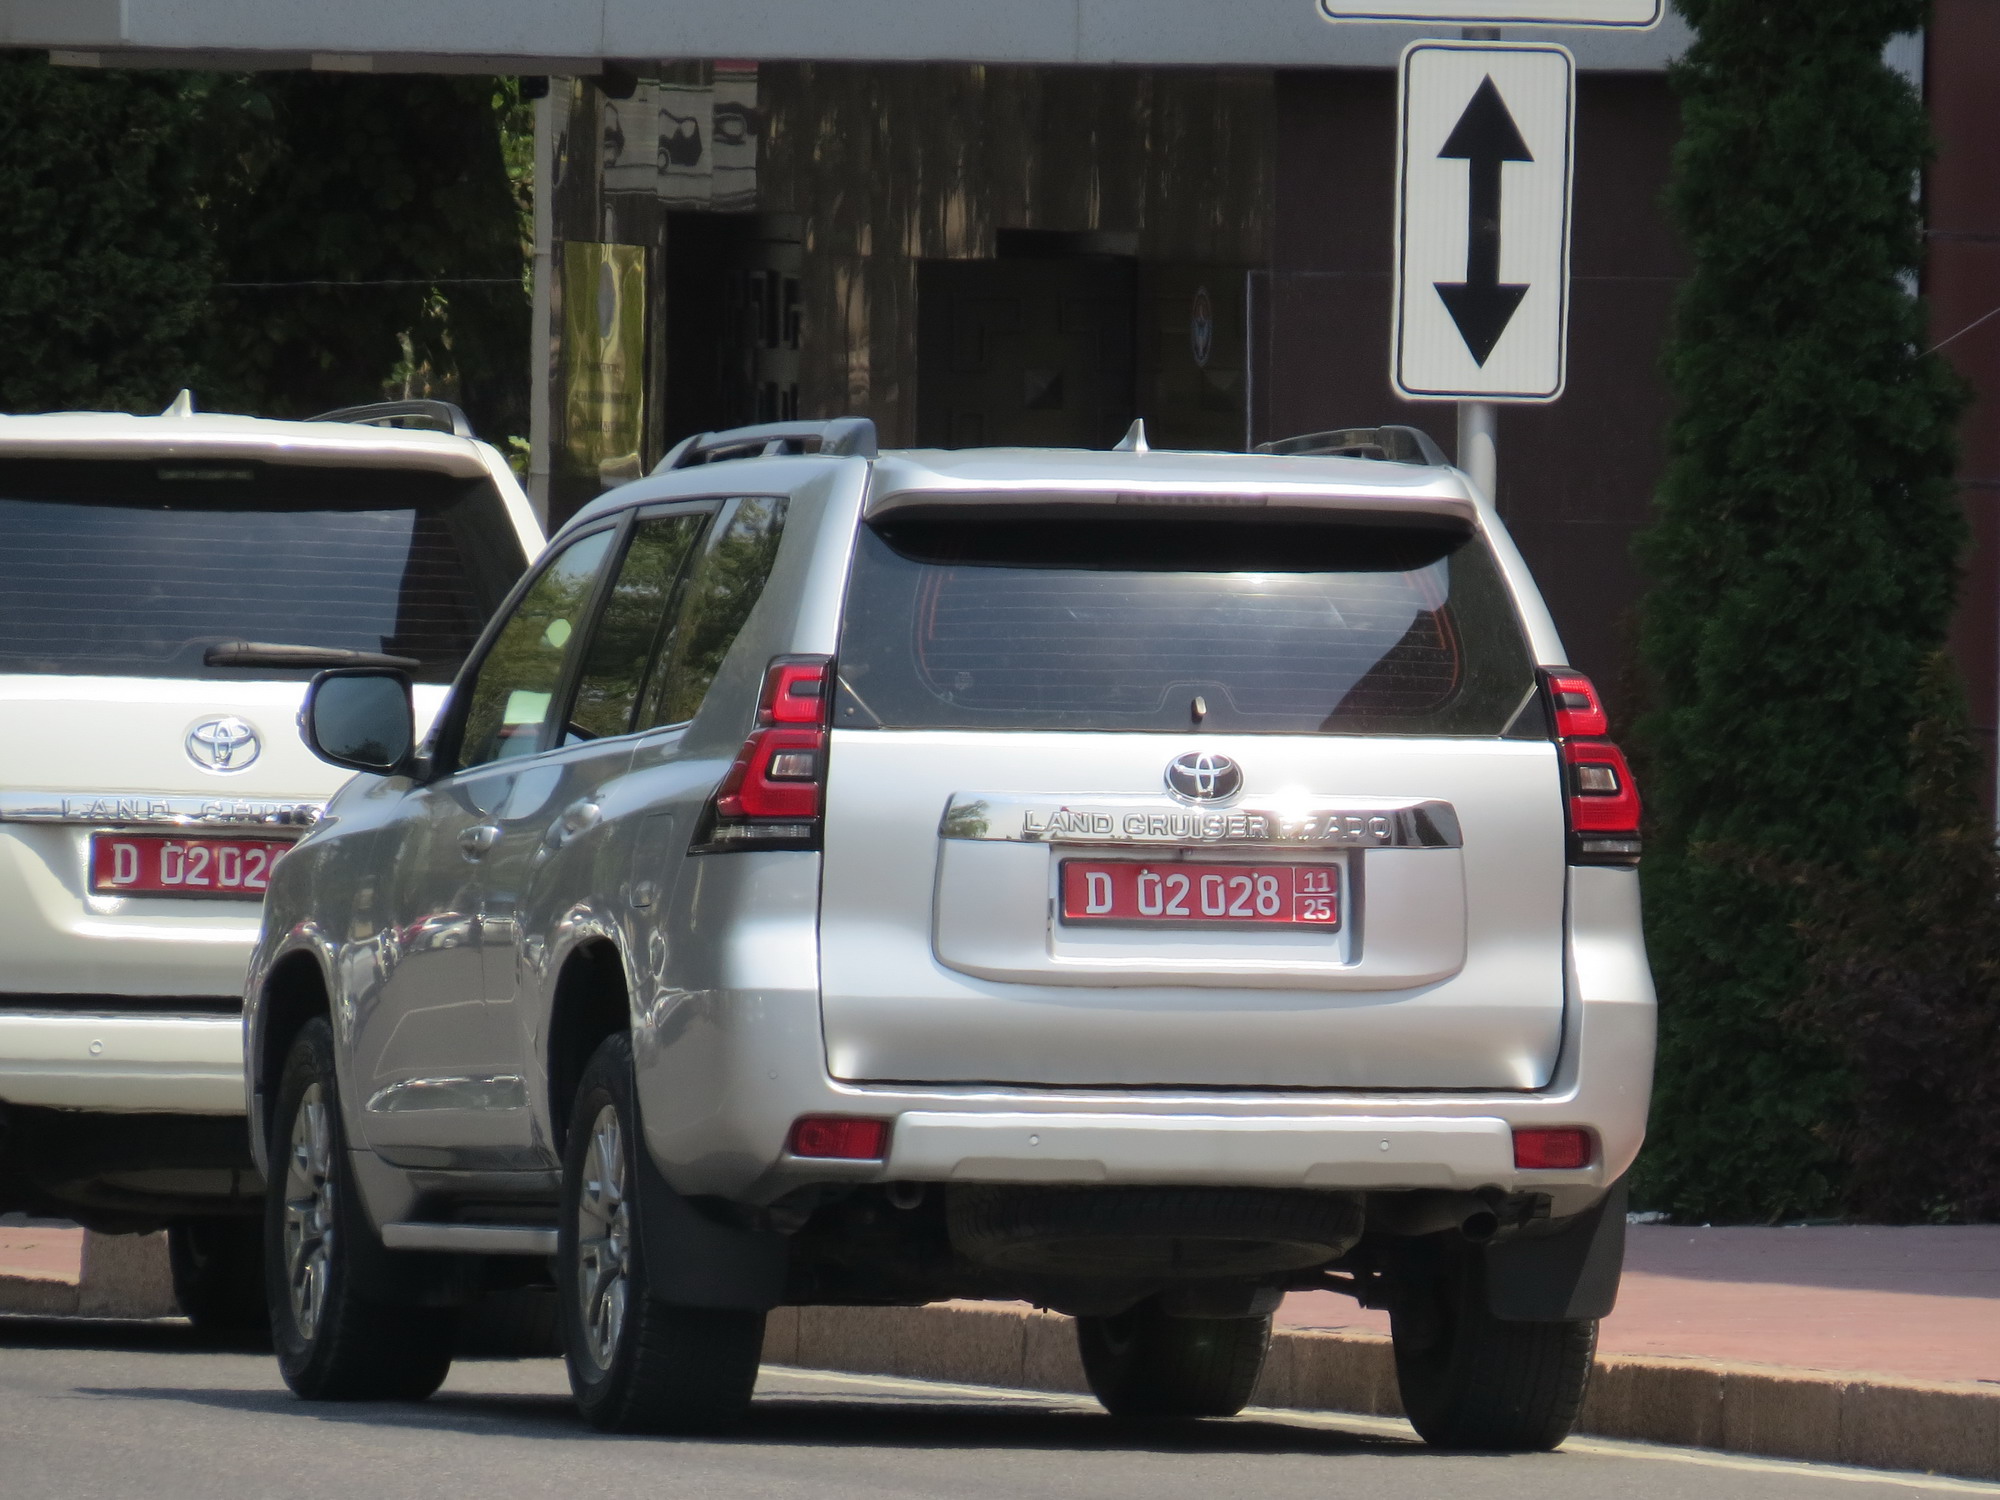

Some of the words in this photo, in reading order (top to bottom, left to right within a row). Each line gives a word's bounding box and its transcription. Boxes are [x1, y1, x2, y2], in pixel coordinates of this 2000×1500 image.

[61, 799, 171, 820] LAND
[1023, 809, 1115, 834] LAND
[1121, 812, 1269, 839] CRUISER
[112, 843, 138, 885] D
[1085, 871, 1113, 914] D
[1303, 872, 1331, 893] 11
[1303, 898, 1331, 920] 25
